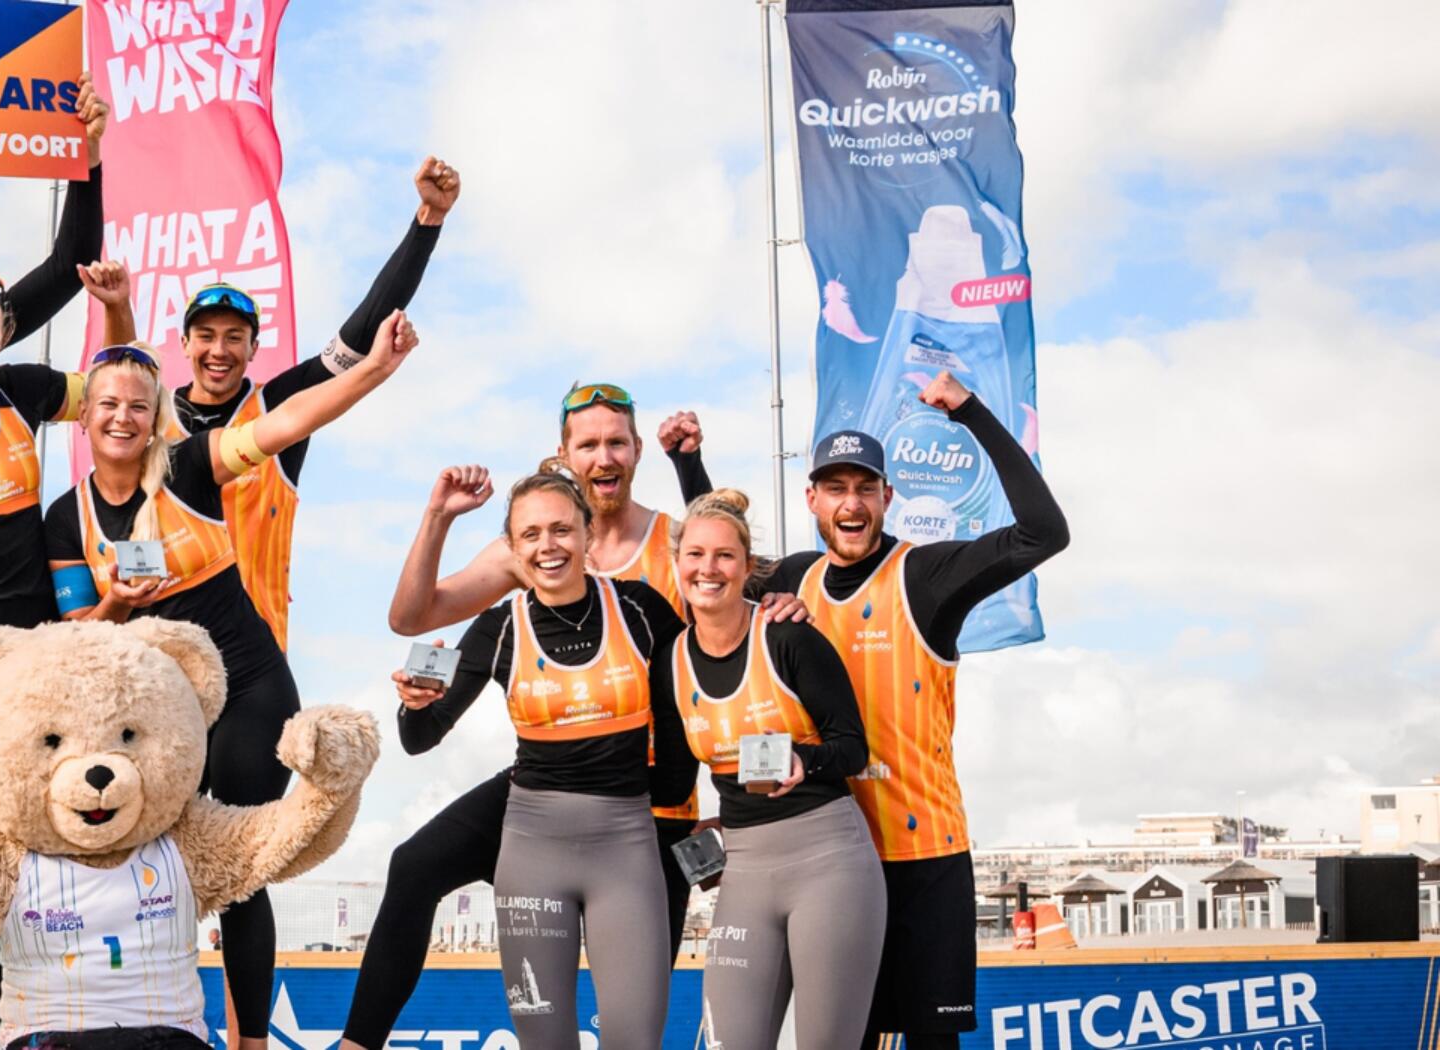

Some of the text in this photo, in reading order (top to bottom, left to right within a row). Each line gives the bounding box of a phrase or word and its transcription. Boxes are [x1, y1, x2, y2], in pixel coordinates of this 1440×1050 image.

[104, 0, 265, 53] WHAT A
[106, 38, 265, 122] WASTE
[866, 65, 926, 89] Robijn
[799, 85, 1001, 127] Quickwash
[828, 127, 974, 150] Wasmiddel voor
[849, 145, 957, 167] korte wasjes
[104, 199, 278, 275] WHAT A
[961, 280, 1025, 303] NIEUW
[892, 436, 974, 472] Robijn
[897, 469, 962, 484] Quickwash
[903, 514, 947, 529] KORTE
[856, 631, 888, 639] STAR
[571, 681, 590, 700] 2
[543, 898, 563, 913] POT
[46, 921, 84, 932] BEACH
[725, 926, 748, 941] POT
[103, 936, 122, 969] 1
[991, 972, 1322, 1050] FITCASTER
